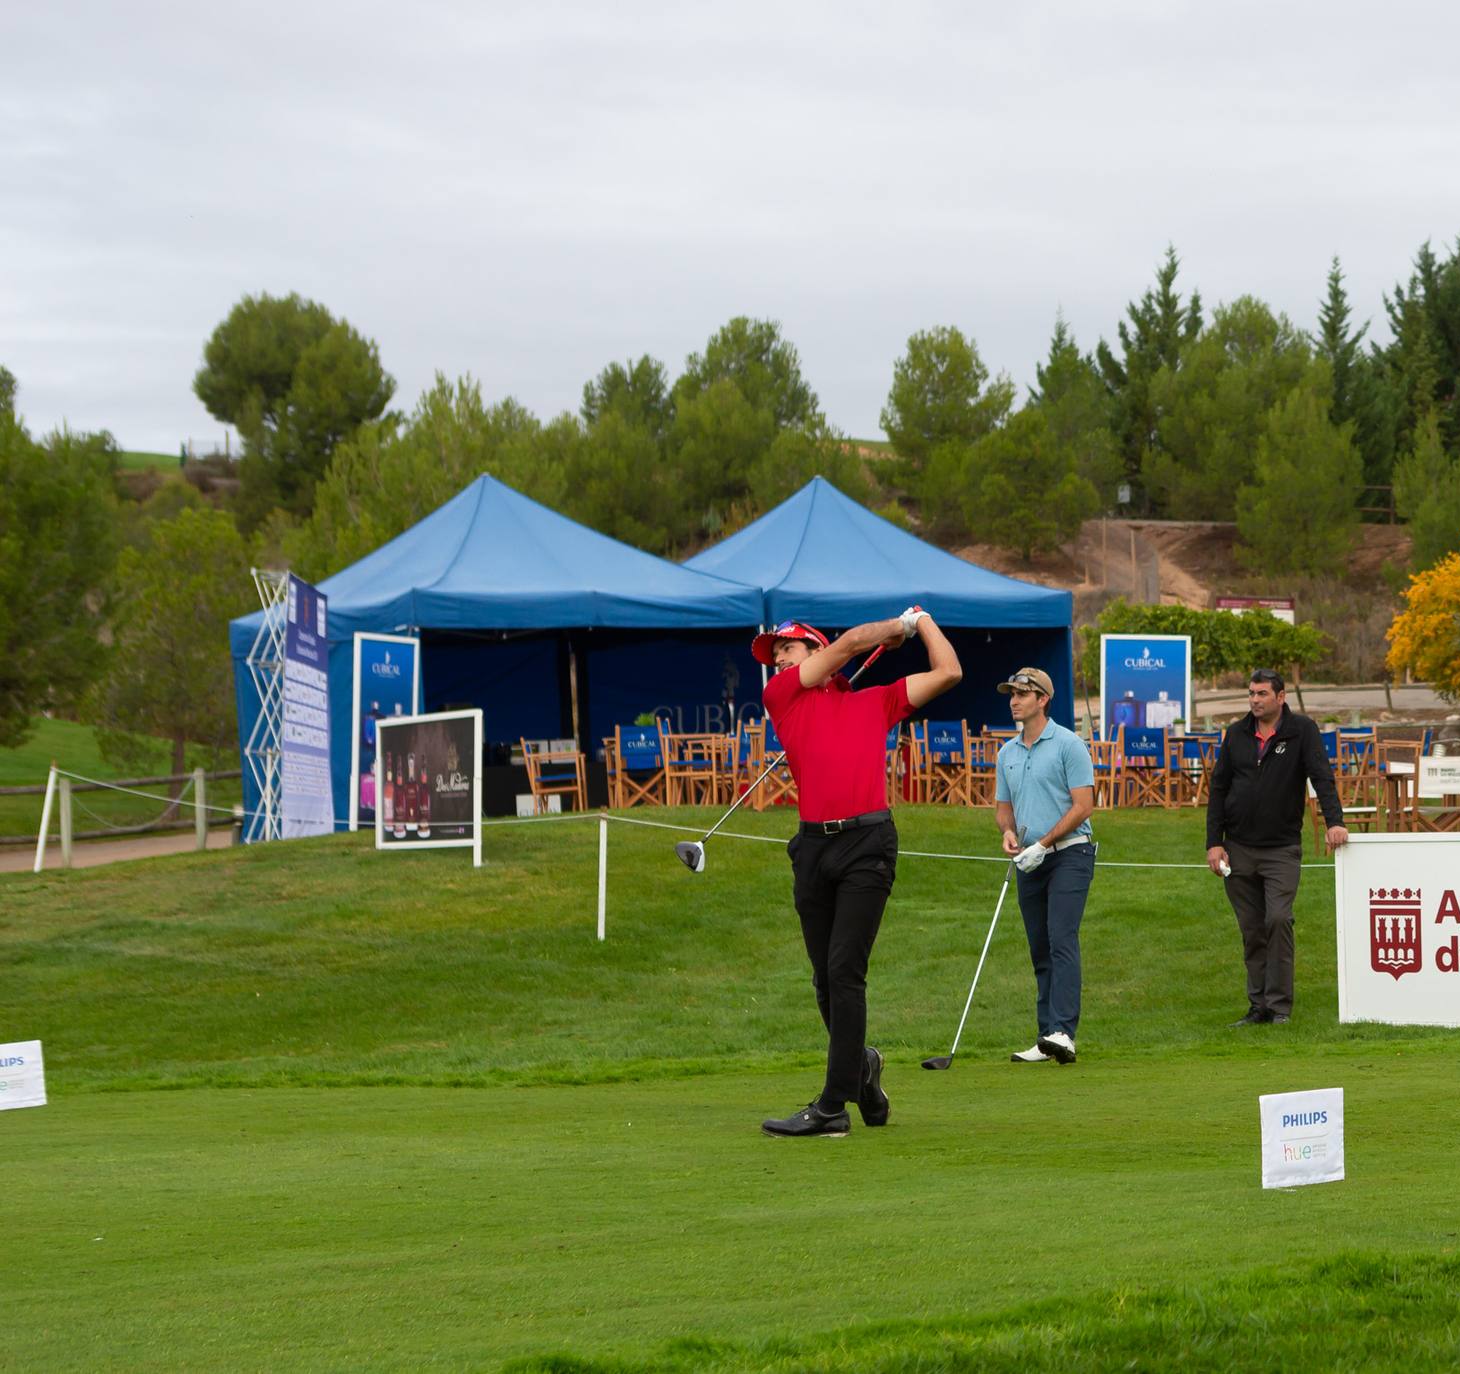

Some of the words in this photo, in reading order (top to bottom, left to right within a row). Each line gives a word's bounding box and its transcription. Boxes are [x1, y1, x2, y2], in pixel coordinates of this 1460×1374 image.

[1124, 657, 1166, 669] CUBICAL
[0, 1056, 25, 1067] LIPS
[1282, 1110, 1328, 1128] PHILIPS
[1284, 1143, 1312, 1163] hue
